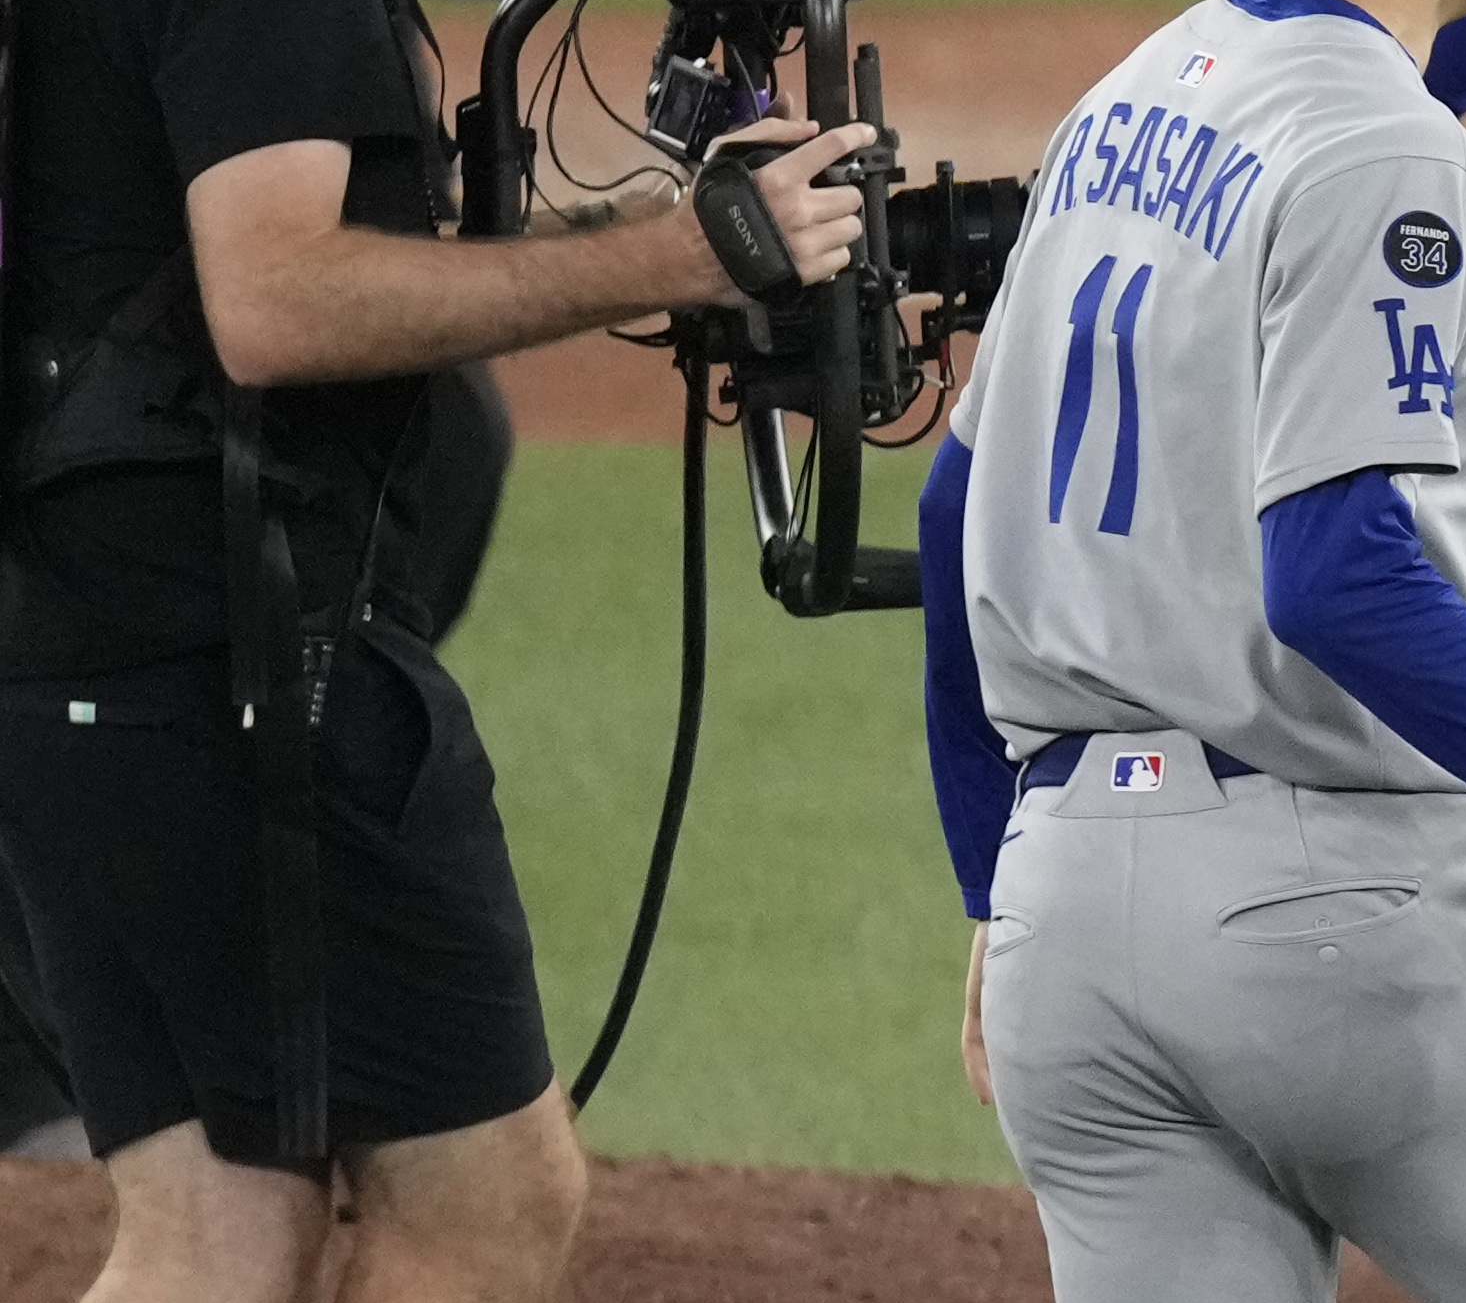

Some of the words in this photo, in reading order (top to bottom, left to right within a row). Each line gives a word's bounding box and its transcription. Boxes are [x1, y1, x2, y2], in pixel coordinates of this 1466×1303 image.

[1086, 102, 1263, 261] SASAKI
[728, 204, 761, 256] SONY
[1400, 224, 1450, 242] FERNANDO
[1400, 237, 1448, 275] 34
[1049, 254, 1154, 536] 11
[1373, 297, 1455, 420] LA
